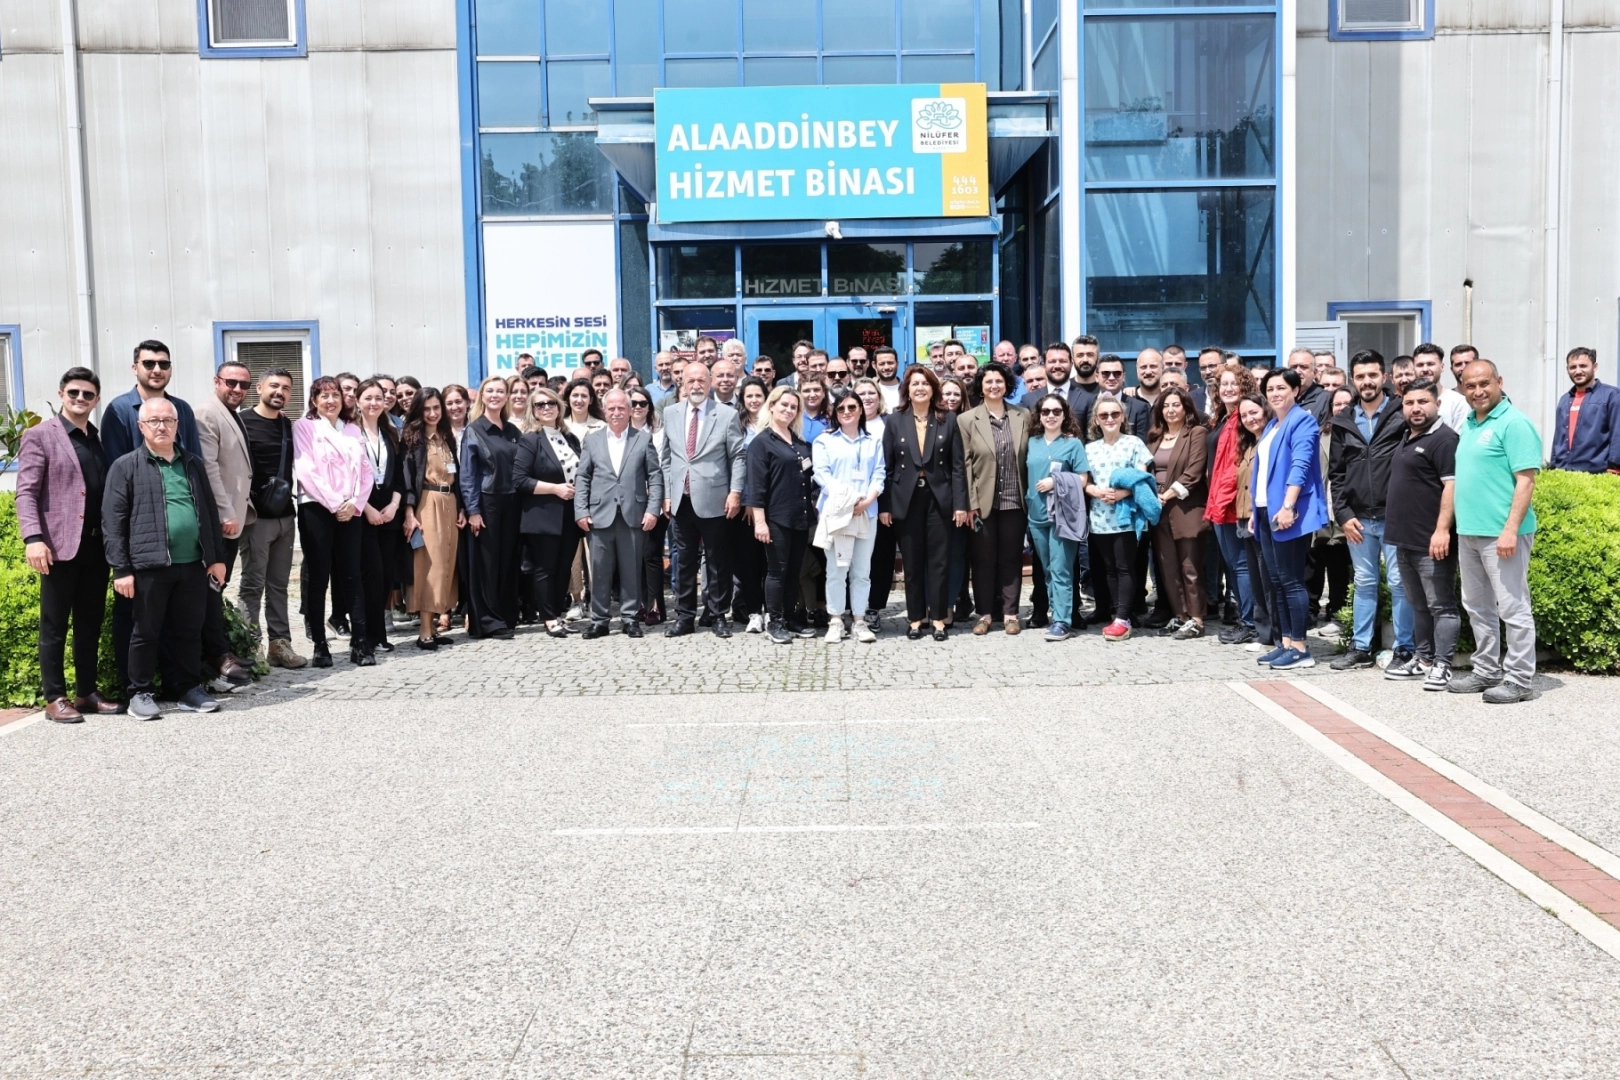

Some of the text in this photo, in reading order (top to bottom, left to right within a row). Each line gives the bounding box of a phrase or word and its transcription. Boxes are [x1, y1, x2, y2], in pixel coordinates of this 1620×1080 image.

[667, 112, 899, 152] ALAADDİNBEY
[920, 131, 959, 139] NİLÜFER
[669, 160, 915, 200] HİZMET BİNASI
[953, 175, 977, 186] 444
[951, 184, 979, 195] 1603
[495, 314, 607, 329] HERKESİN SESİ
[496, 329, 608, 349] HEPİMİZİN
